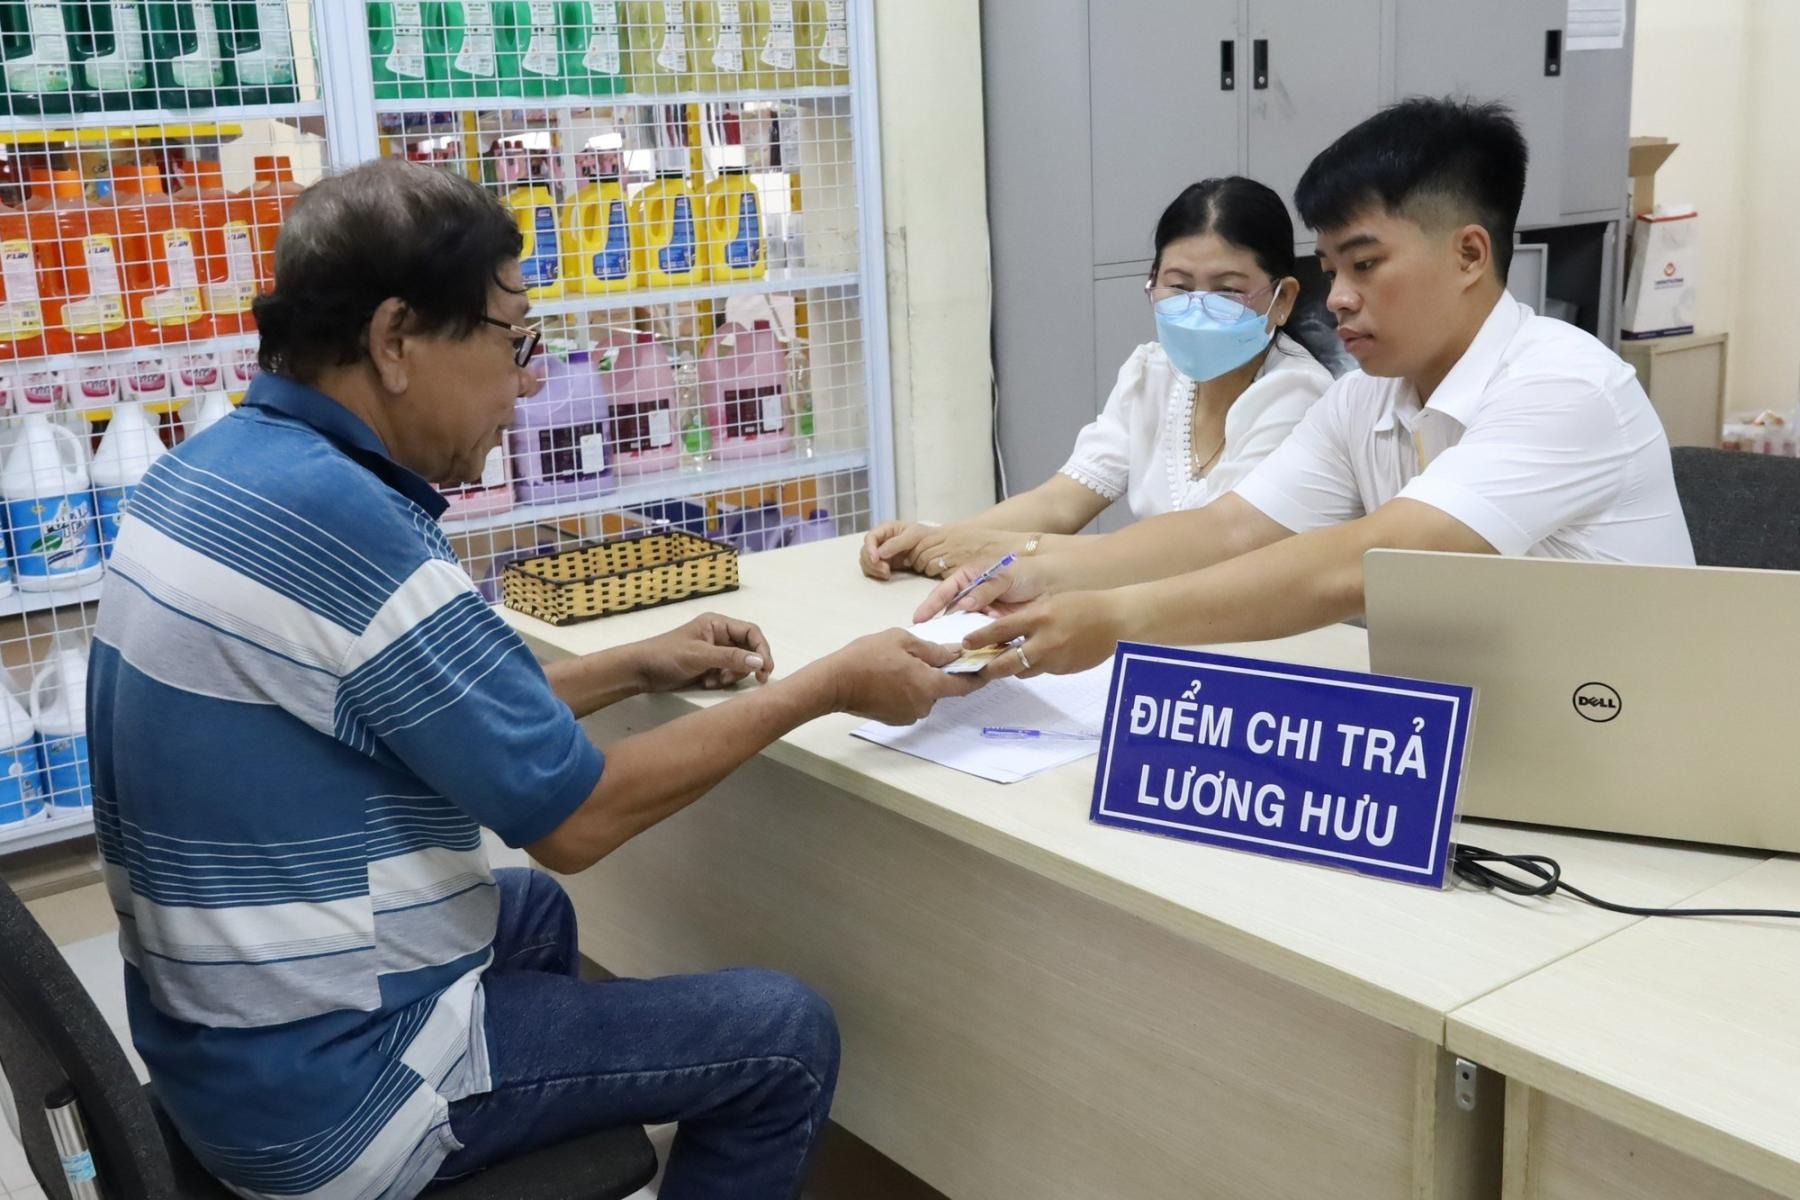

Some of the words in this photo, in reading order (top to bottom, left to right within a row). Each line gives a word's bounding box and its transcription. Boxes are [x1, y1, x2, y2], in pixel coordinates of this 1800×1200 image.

[1130, 679, 1234, 748] ĐIỂM
[1246, 711, 1322, 762] CHI
[1337, 716, 1426, 779] TRẢ
[1578, 696, 1616, 708] DELL
[1137, 764, 1285, 828] LƯƠNG
[1300, 791, 1398, 847] HƯU
